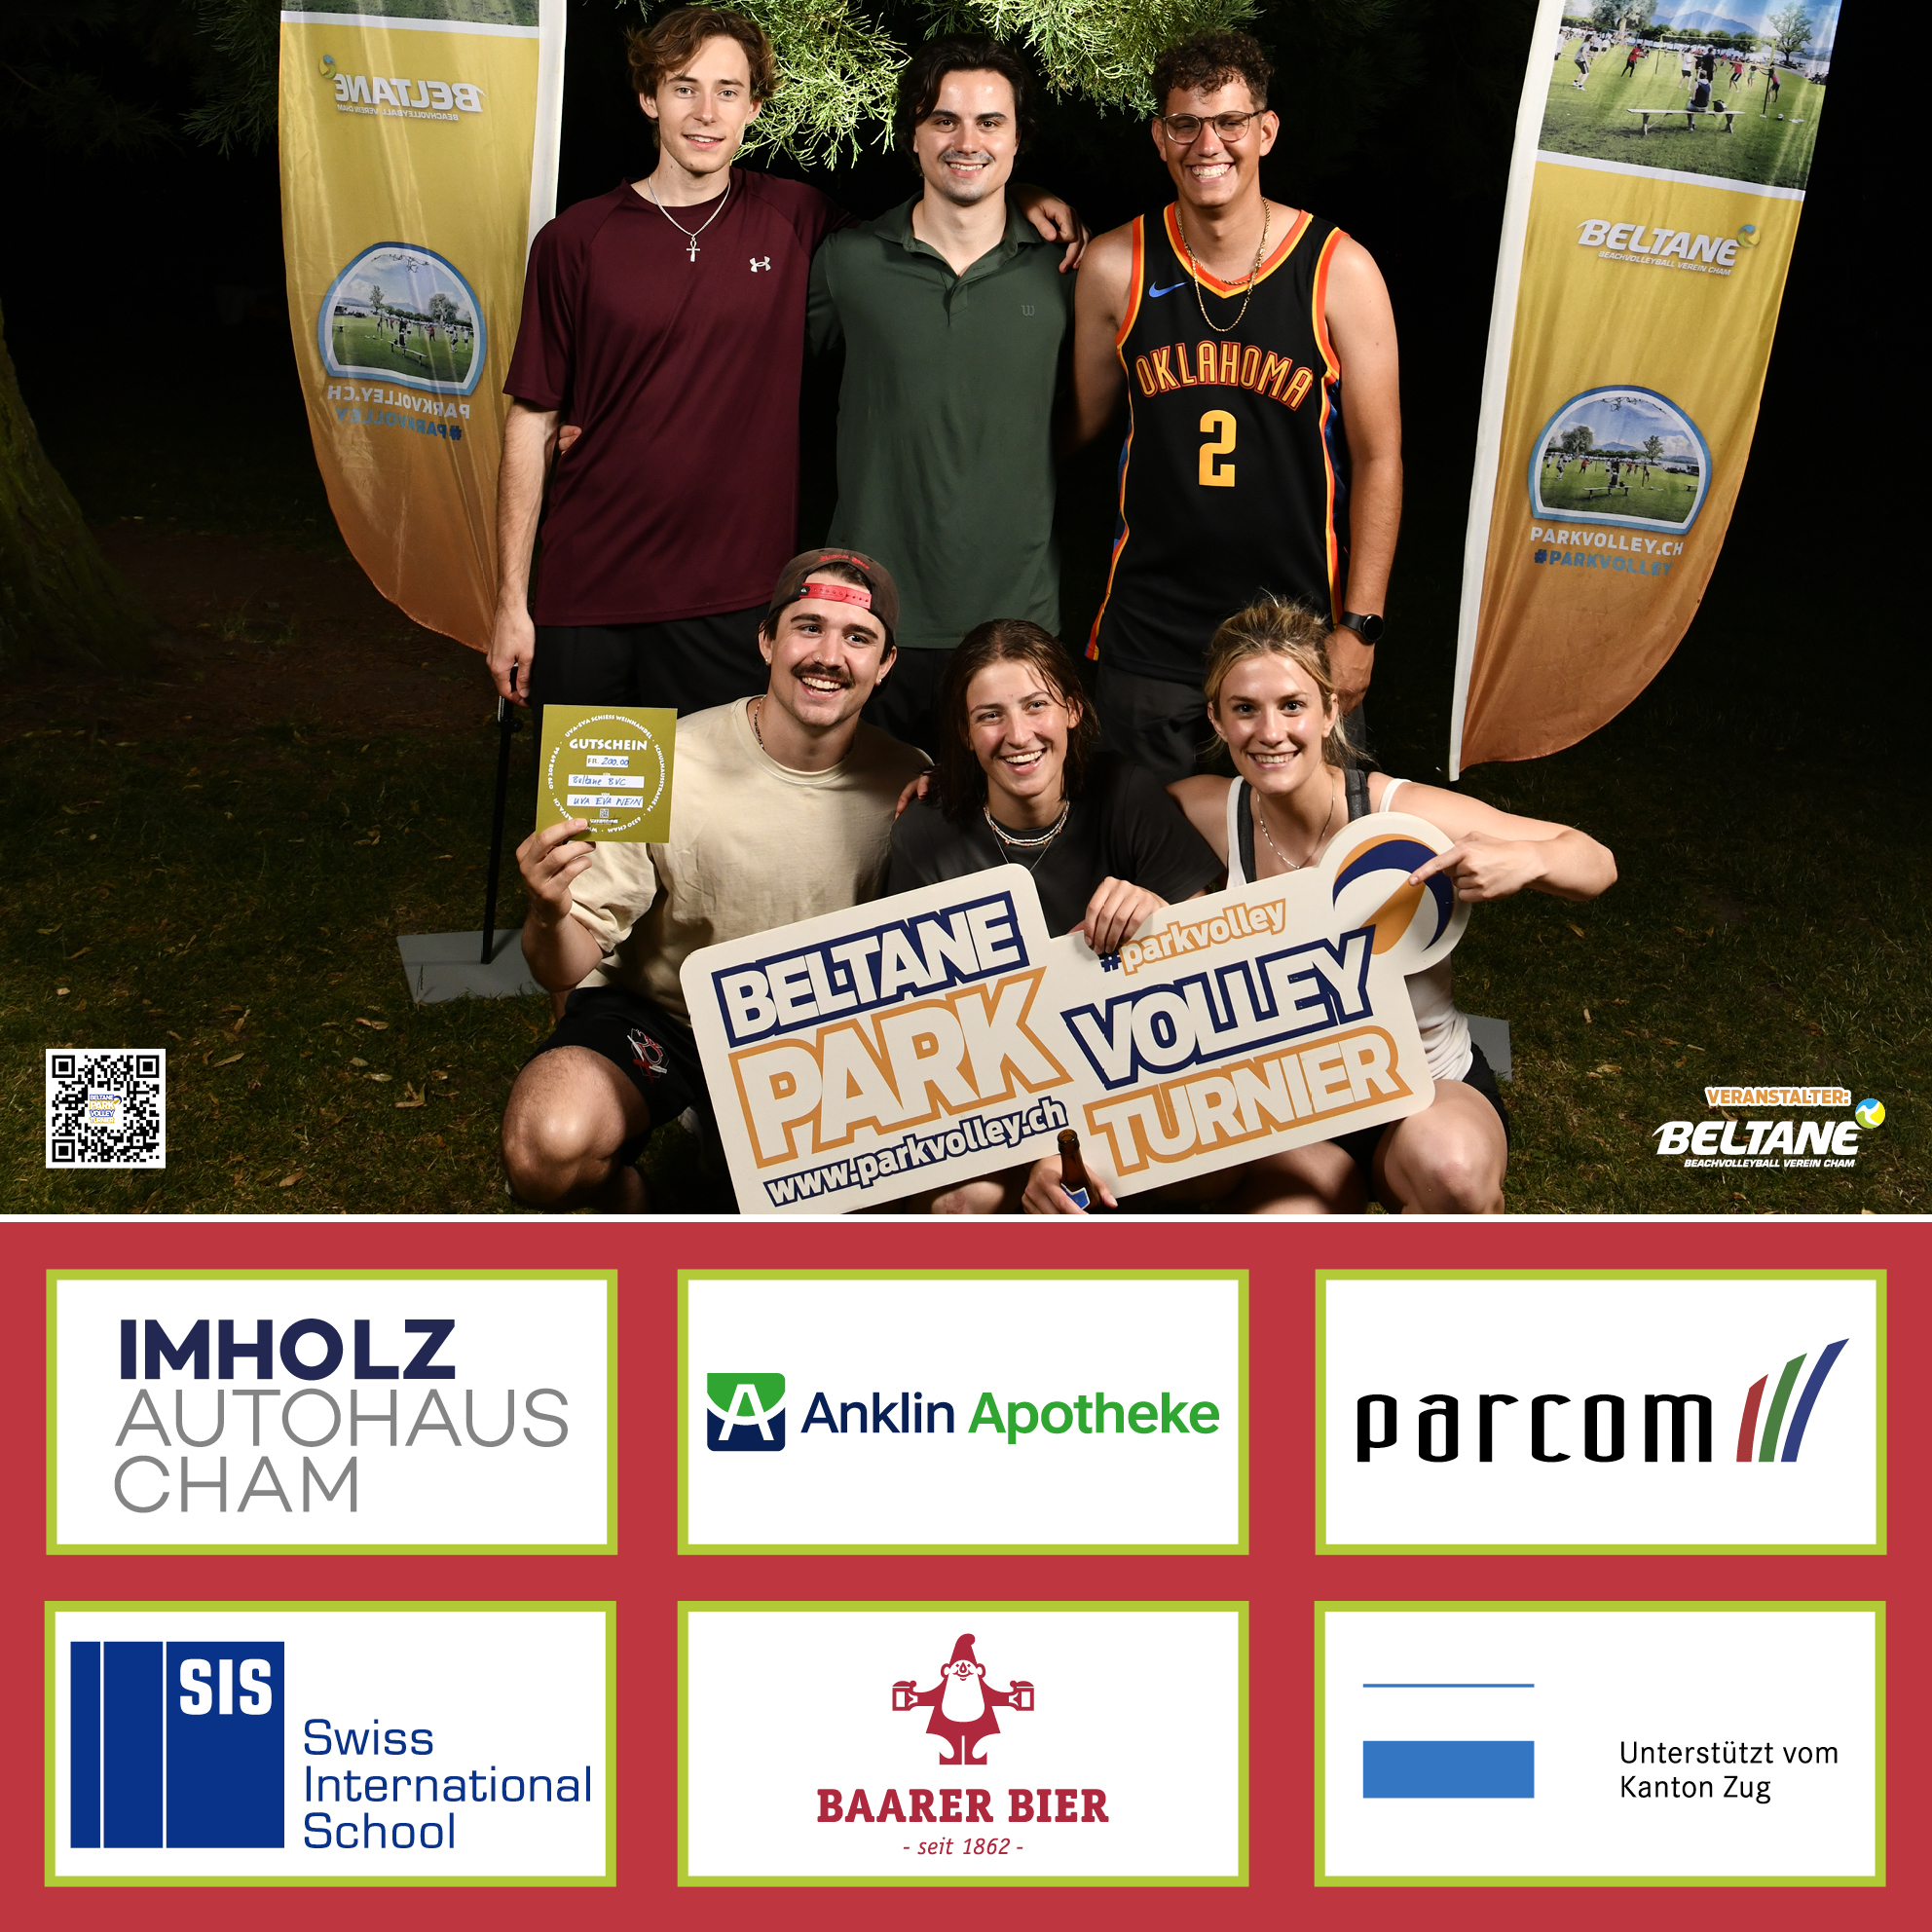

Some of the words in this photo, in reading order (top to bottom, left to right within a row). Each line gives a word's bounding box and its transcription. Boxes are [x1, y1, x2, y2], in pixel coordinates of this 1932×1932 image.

[1577, 218, 1741, 267] BELTANE
[1598, 250, 1675, 268] BEACHVOLLEYBALL
[1677, 262, 1707, 273] VEREIN
[1707, 266, 1731, 276] CHAM
[1135, 340, 1314, 411] OKLAHOMA
[1198, 409, 1238, 487] 2
[1530, 526, 1685, 557] PARKVOLLEY.CH
[1534, 548, 1673, 576] #PARKVOLLEY
[565, 719, 591, 738] UVA-EVA
[591, 714, 615, 723] SCHIESS
[615, 715, 652, 740] WEINHANDEL
[569, 738, 648, 751] GUTSCHEIN
[652, 744, 665, 806] SCHULHAUSSTRASSE
[607, 823, 627, 834] CHAM
[628, 816, 642, 828] 6330
[1100, 898, 1286, 975] #parkvolley
[712, 892, 1029, 1047] BELTANE
[1061, 925, 1375, 1090] VOLLEY
[730, 967, 1073, 1168] PARK
[1084, 1027, 1412, 1176] TURNIER
[764, 1096, 1068, 1208] www.parkvolley.ch
